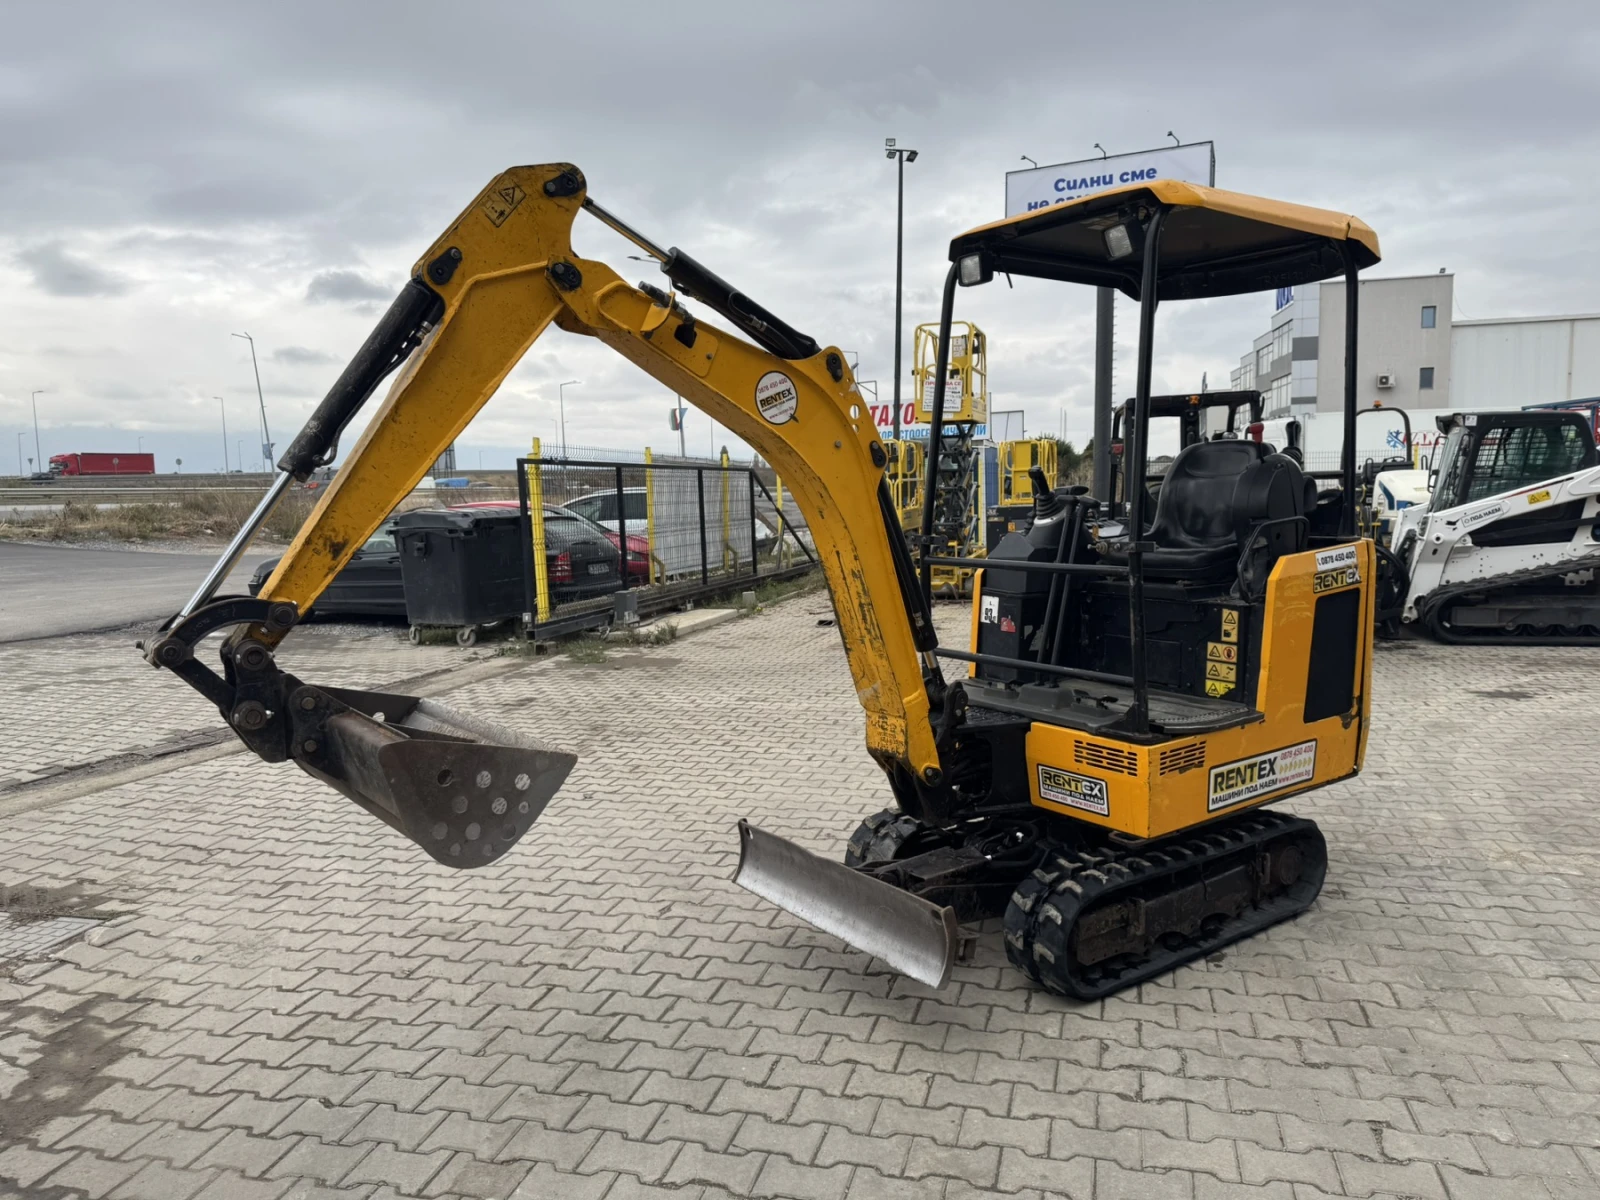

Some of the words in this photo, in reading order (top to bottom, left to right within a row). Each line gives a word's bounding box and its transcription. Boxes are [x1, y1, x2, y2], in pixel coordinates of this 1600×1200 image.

[1054, 174, 1113, 192] Силни
[1119, 167, 1157, 183] сме
[760, 388, 792, 408] RENTEX
[1335, 553, 1345, 562] 450
[1314, 568, 1360, 591] RENTEX
[1281, 751, 1293, 760] 0878
[1293, 748, 1303, 757] 450
[1304, 745, 1314, 753] 400
[1043, 771, 1102, 798] RENTEX
[1213, 756, 1278, 793] RENTEX
[1279, 769, 1311, 784] www.rentex.bg
[1072, 791, 1085, 800] ПОД
[1086, 796, 1104, 805] НАЕМ
[1211, 789, 1244, 805] МАШИНИ
[1244, 784, 1259, 795] ПОД
[1259, 777, 1278, 790] НАЕМ
